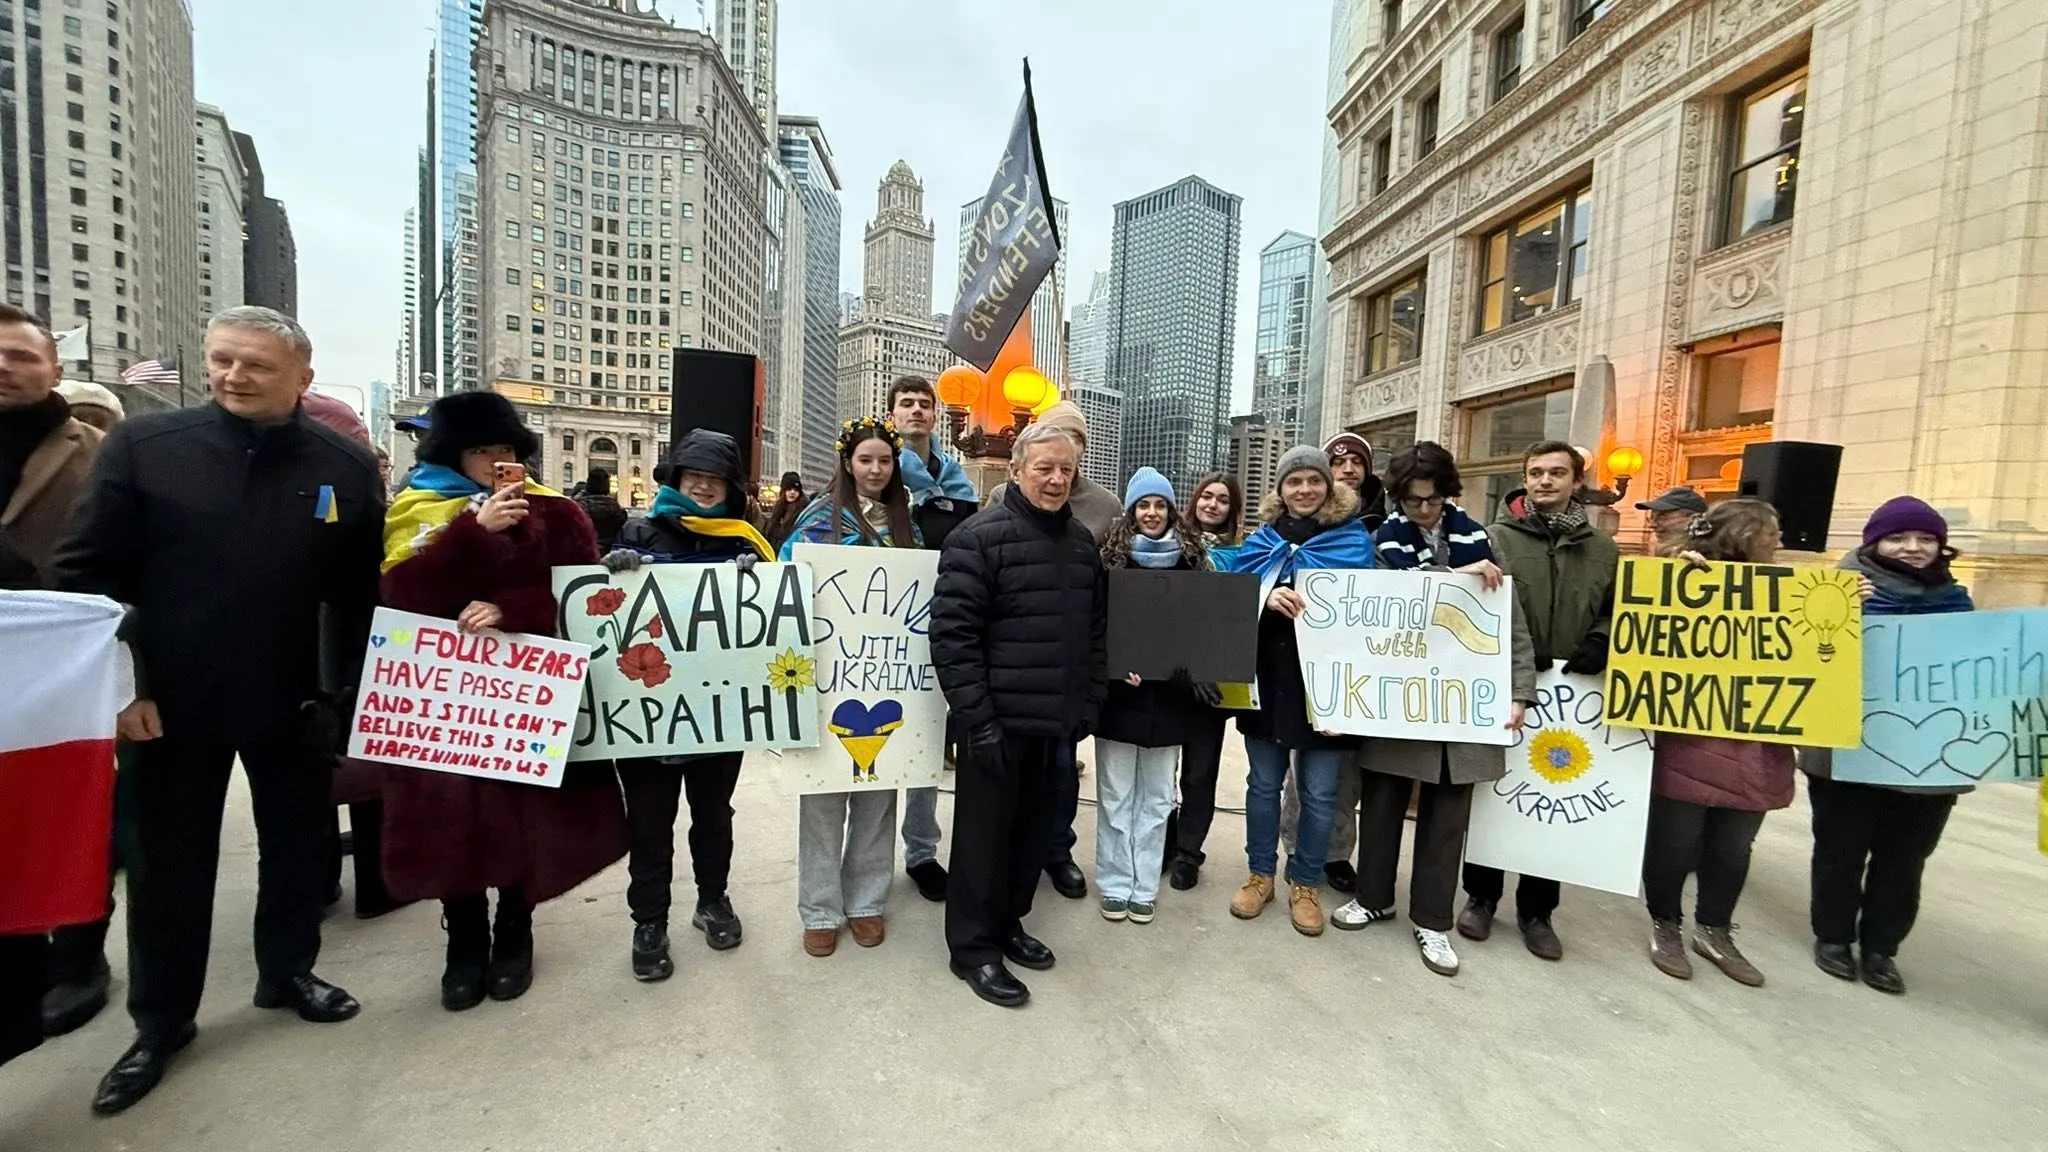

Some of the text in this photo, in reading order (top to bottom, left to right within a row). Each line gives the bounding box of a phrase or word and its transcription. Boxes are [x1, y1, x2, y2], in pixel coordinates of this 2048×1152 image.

[1302, 571, 1432, 630] Stand
[1621, 561, 1794, 612] LIGHT
[560, 565, 811, 660] СЛАВА
[1613, 611, 1793, 661] OVERCOMES
[415, 627, 588, 681] FOUR YEARS
[839, 635, 909, 660] WITH
[1365, 631, 1427, 659] with
[373, 656, 554, 706] HAVE PASSED
[815, 659, 936, 694] UKRAINE
[1306, 661, 1497, 727] Ukraine
[363, 691, 567, 737] AND I STILL CAN'T
[1607, 668, 1816, 736] DARKNEZZ
[1973, 711, 1990, 731] is
[358, 714, 526, 754] BELIEVE THIS IS
[492, 758, 511, 772] TO
[516, 762, 548, 778] US
[1494, 769, 1625, 825] UKRAINE
